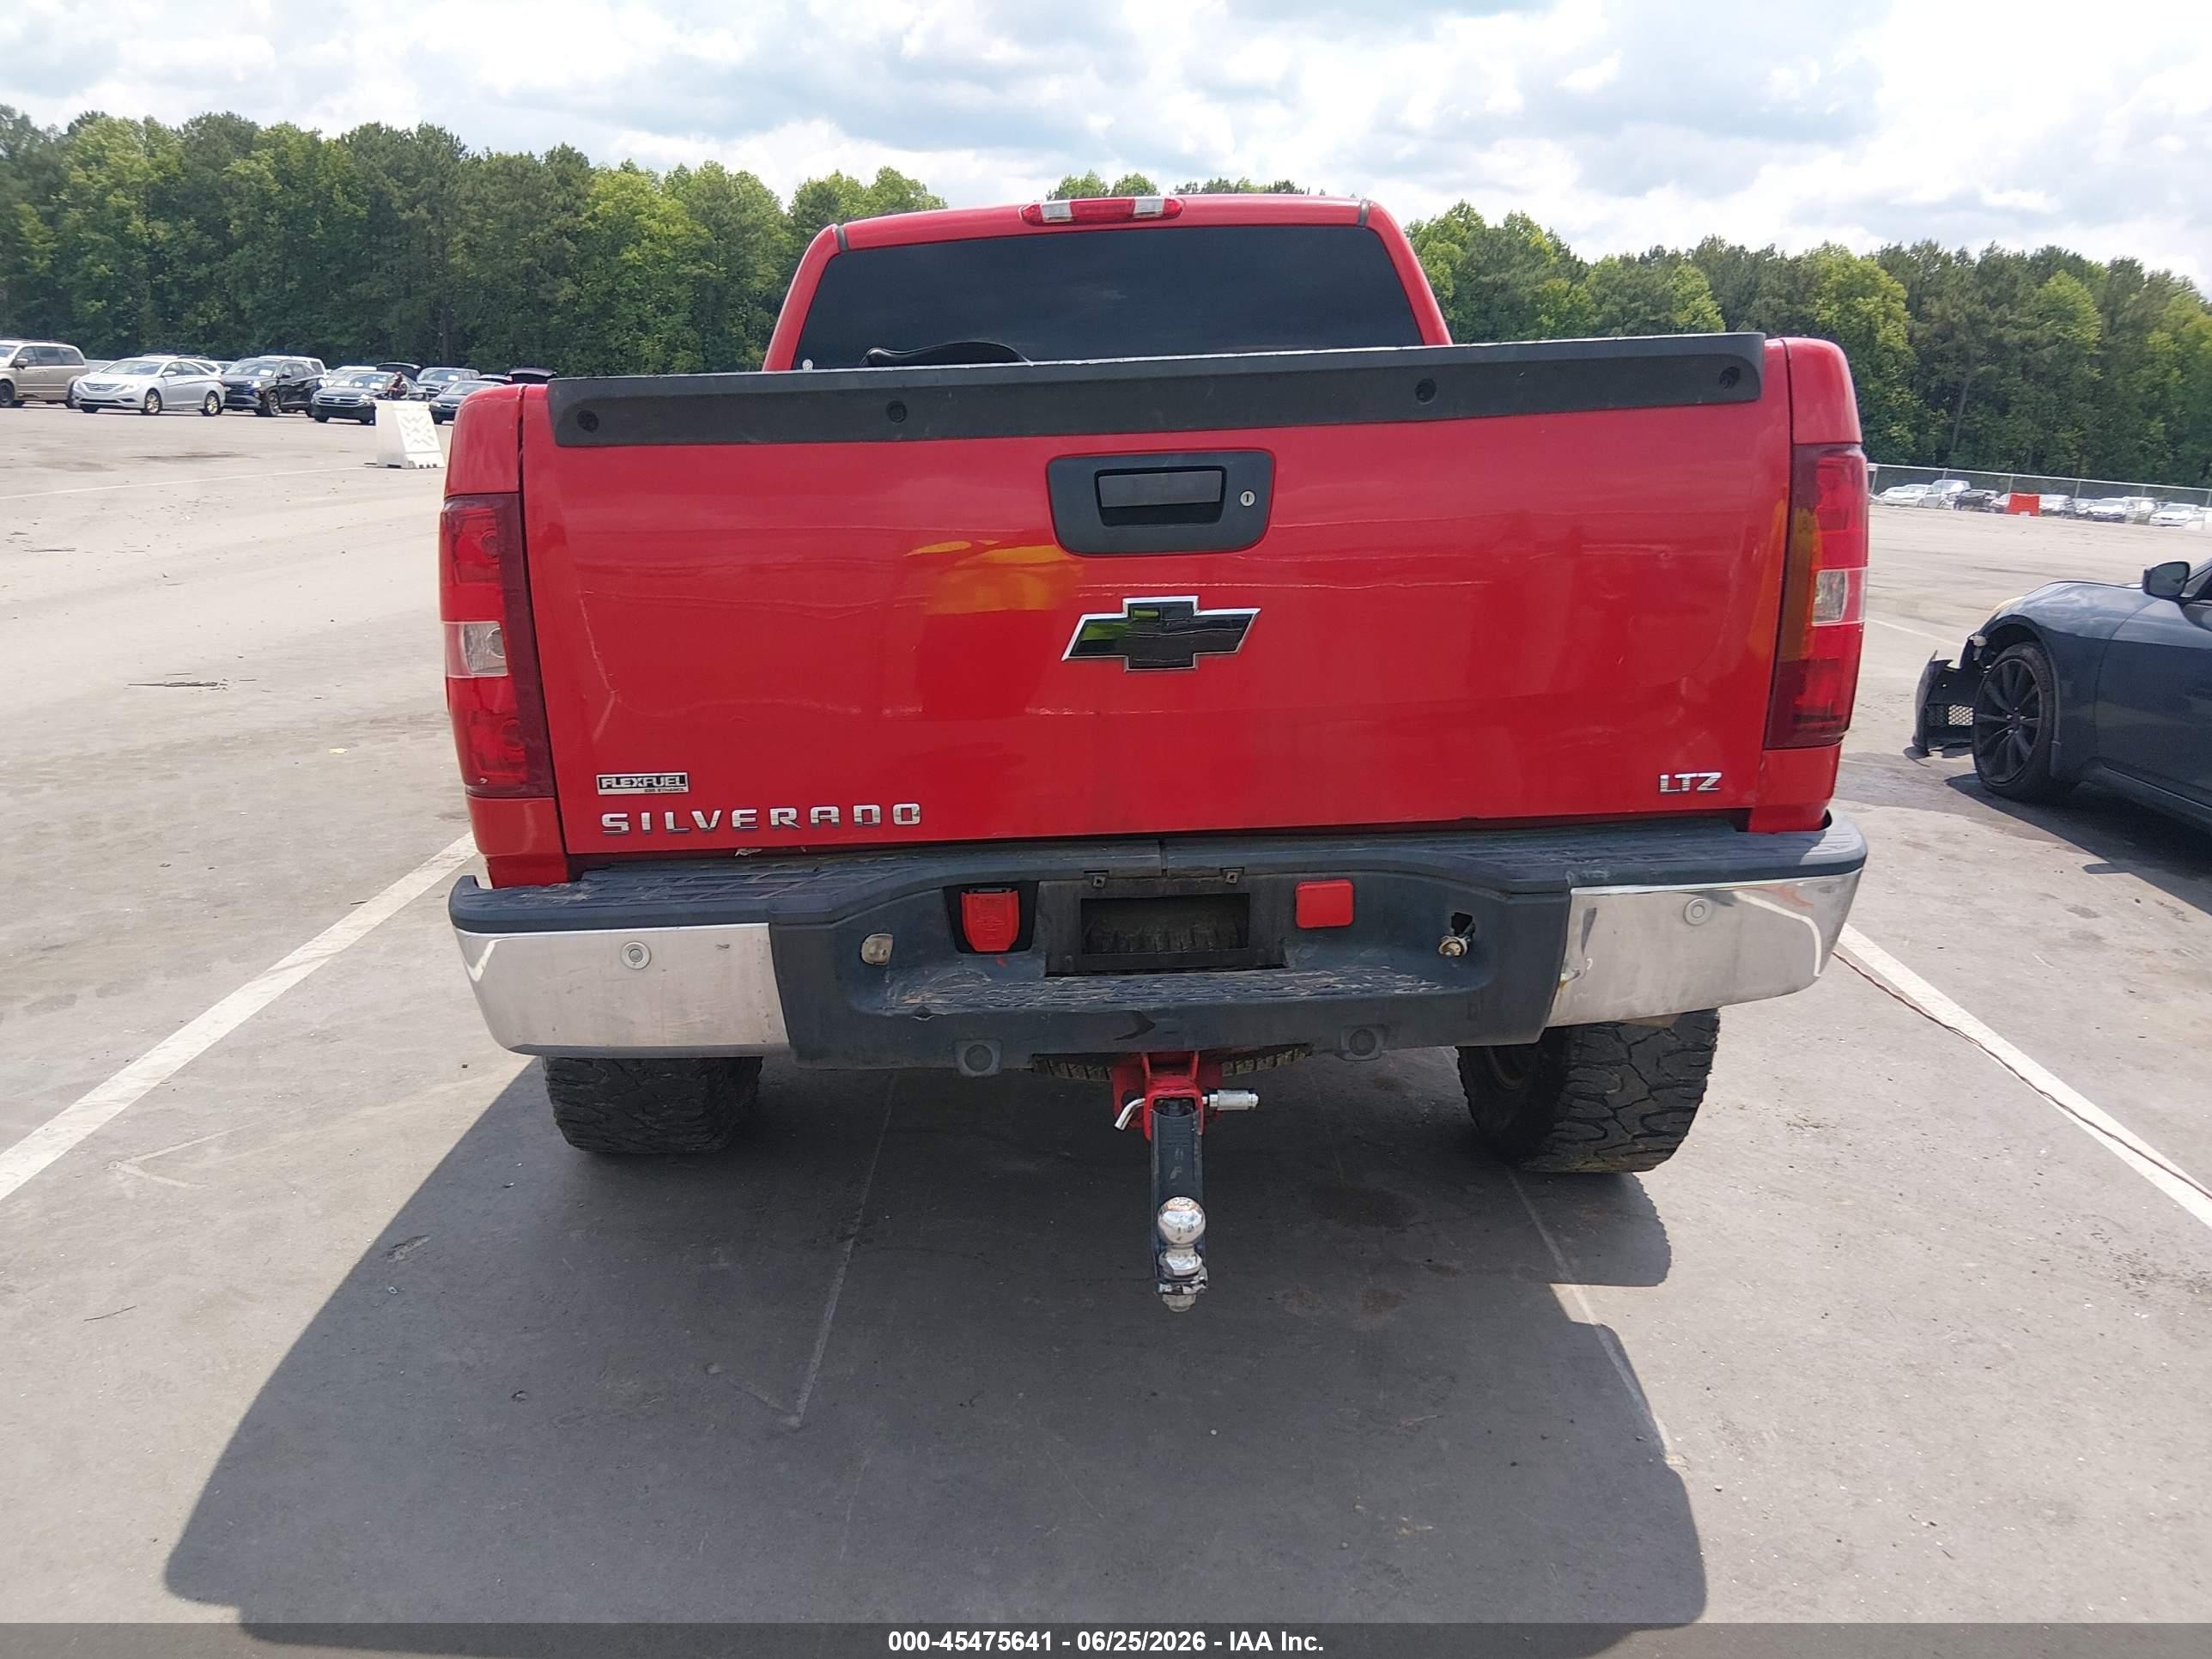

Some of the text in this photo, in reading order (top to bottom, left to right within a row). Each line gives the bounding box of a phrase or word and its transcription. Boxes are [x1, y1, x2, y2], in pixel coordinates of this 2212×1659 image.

[601, 776, 685, 788] FLEXFUEL
[1660, 772, 1723, 793] LTZ
[602, 803, 921, 834] SILVERADO
